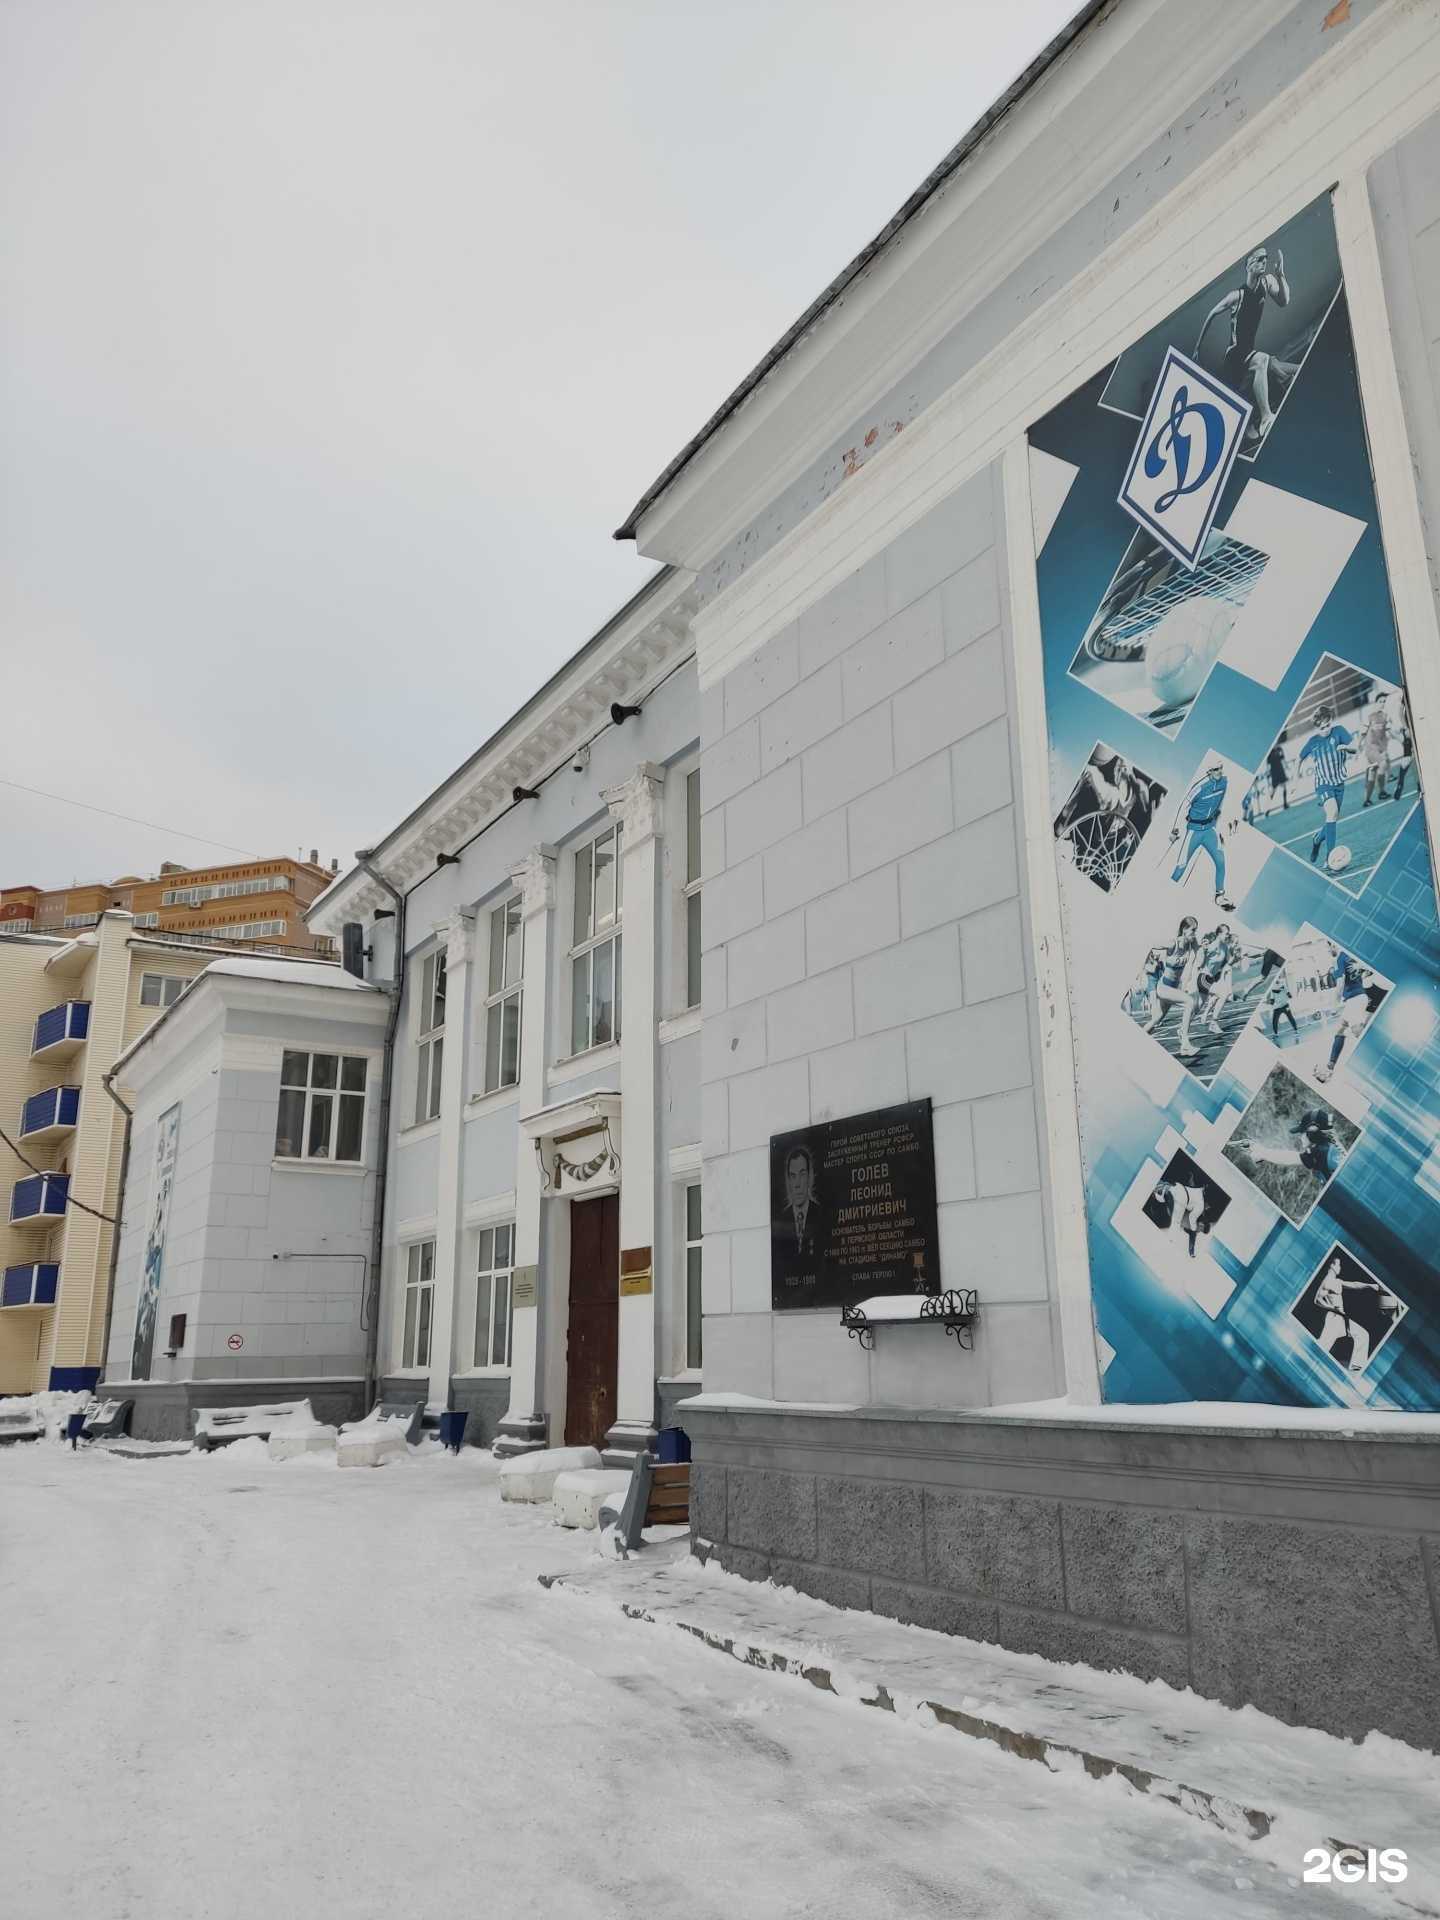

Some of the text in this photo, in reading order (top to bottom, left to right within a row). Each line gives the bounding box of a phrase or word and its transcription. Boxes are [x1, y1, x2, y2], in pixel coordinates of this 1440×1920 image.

[851, 1163, 889, 1183] ГОЛЕВ
[850, 1183, 893, 1201] ЛЕОНИД
[838, 1198, 907, 1224] ДМИТРИЕВИЧ
[878, 1230, 905, 1241] ОБЛАСТИ
